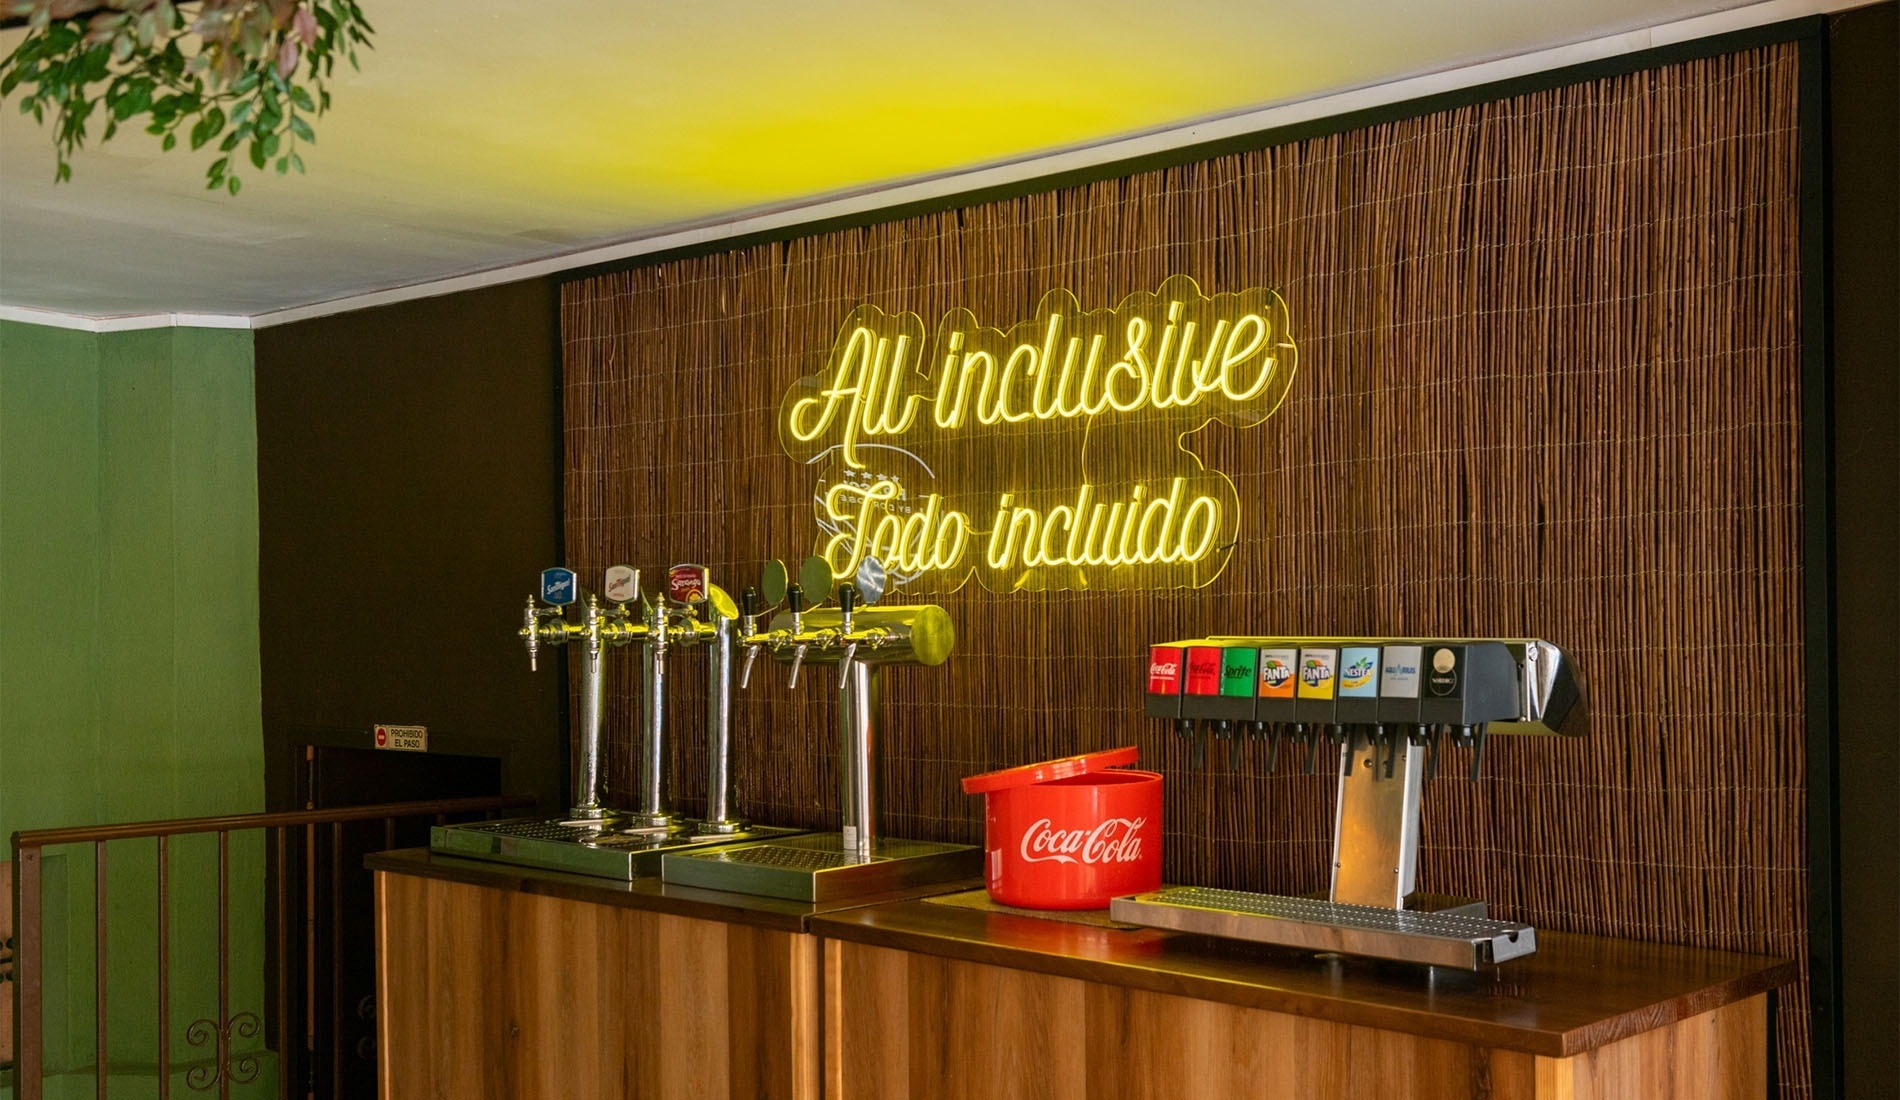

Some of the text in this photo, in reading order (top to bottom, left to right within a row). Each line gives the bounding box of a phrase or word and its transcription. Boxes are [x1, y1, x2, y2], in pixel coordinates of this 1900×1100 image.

[790, 300, 1279, 468] All inclusive
[825, 477, 1221, 580] Todo incluido
[1224, 665, 1252, 678] Sprite
[1263, 667, 1290, 681] FANTA
[1303, 667, 1330, 681] FANTA
[1344, 665, 1374, 677] NESTEA
[390, 729, 424, 739] PROHIBIDO
[395, 739, 420, 748] EL PASO
[1020, 817, 1147, 865] Coca-Cola
